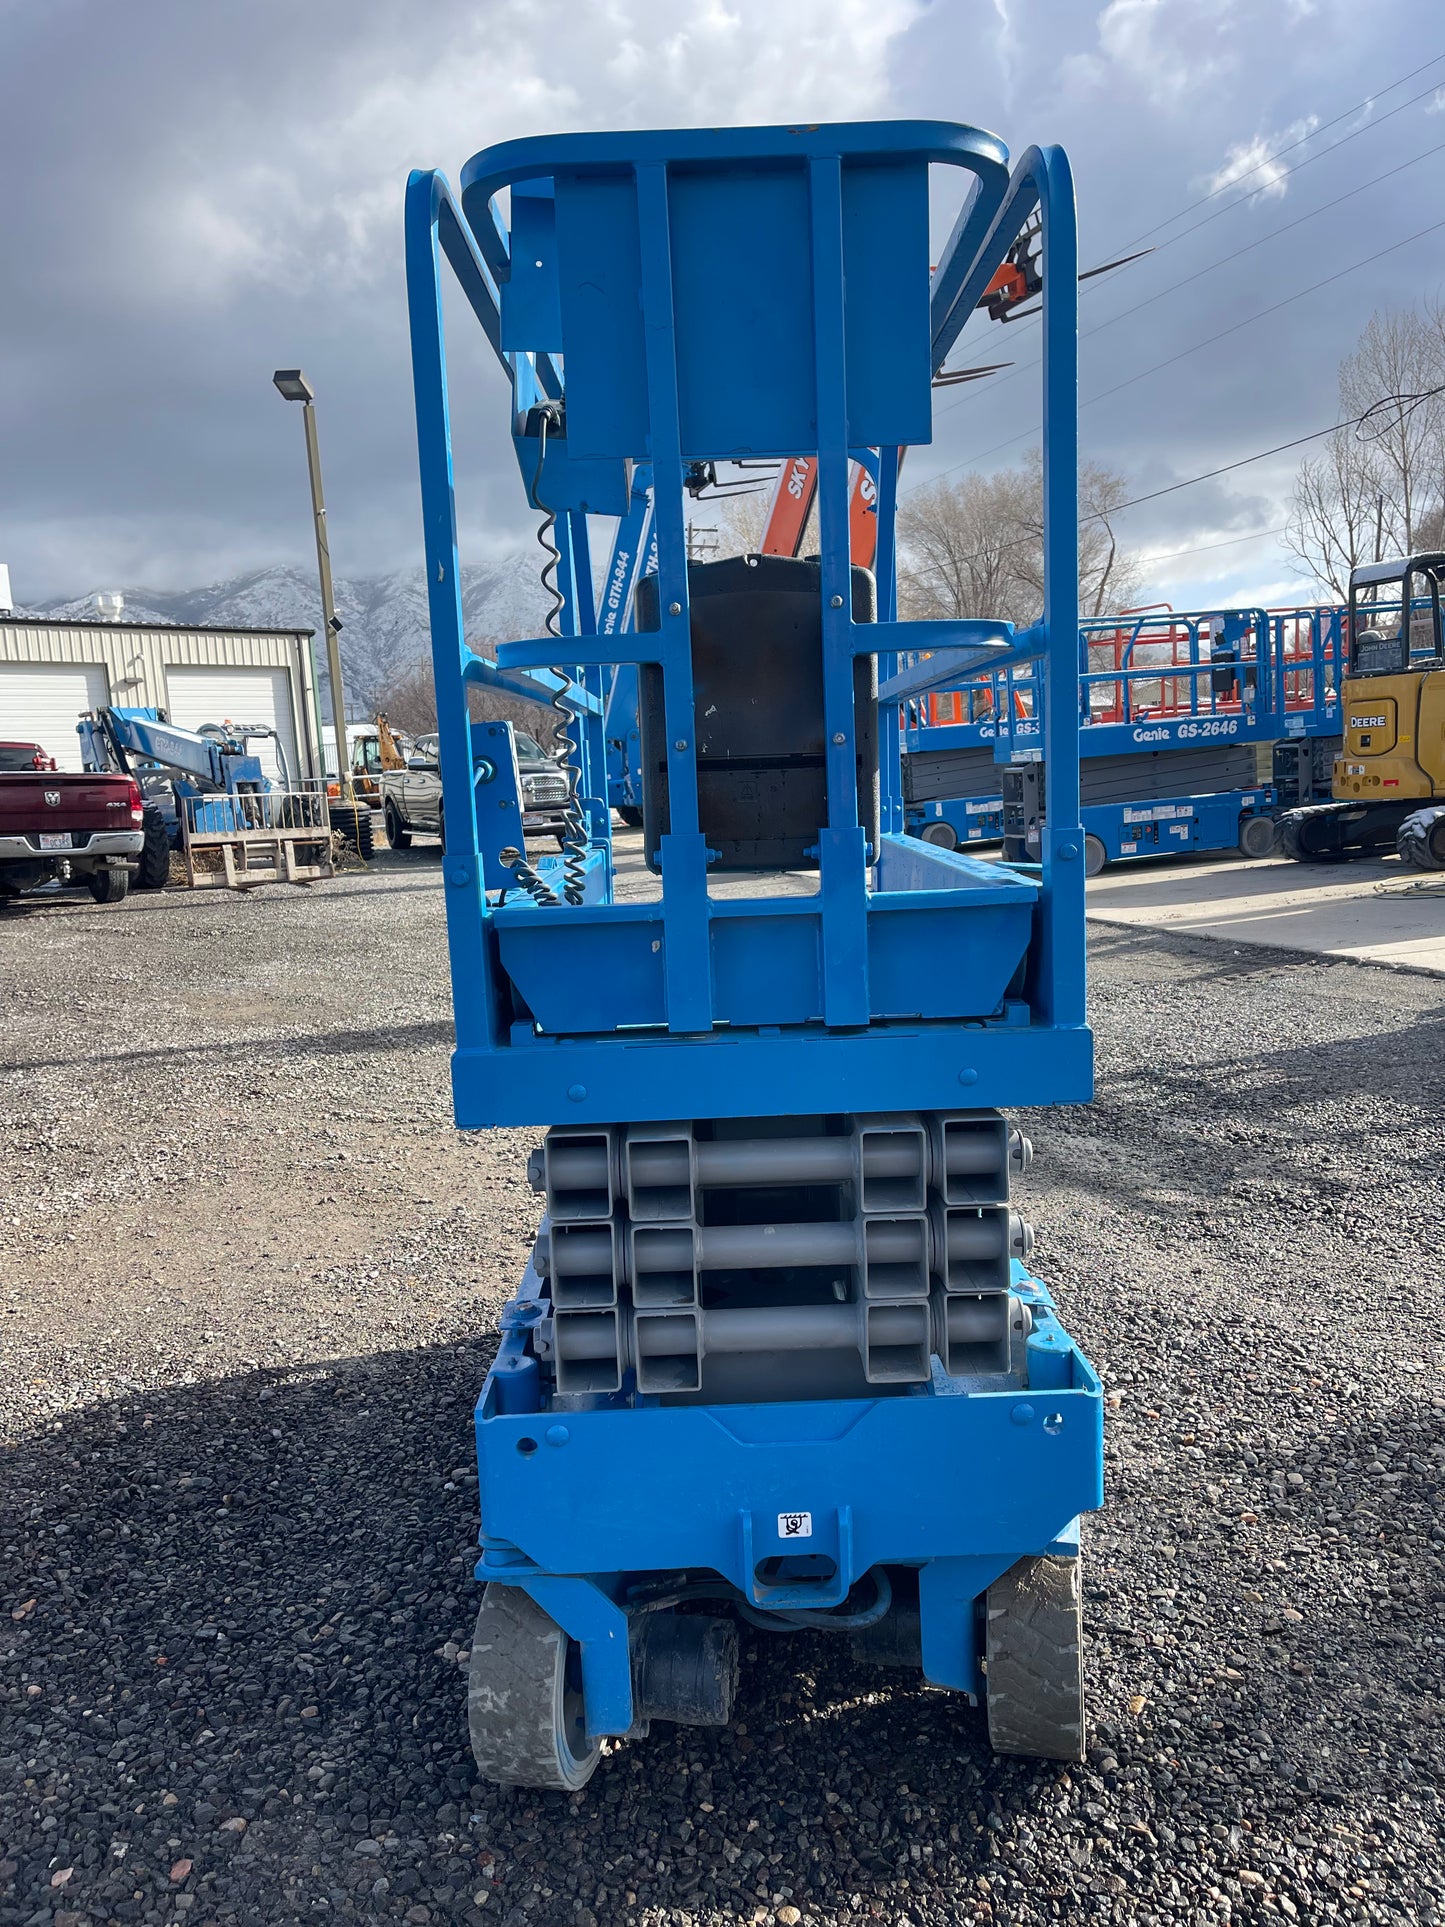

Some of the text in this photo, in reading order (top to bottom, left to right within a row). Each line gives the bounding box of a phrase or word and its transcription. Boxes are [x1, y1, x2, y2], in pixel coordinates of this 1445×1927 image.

[787, 457, 809, 500] SKY
[608, 550, 630, 609] GTH-844
[1360, 641, 1401, 653] JOHN DEERE
[979, 725, 1009, 738] Geie
[1132, 719, 1239, 743] Genie GS-2646
[1350, 716, 1386, 729] DEERE
